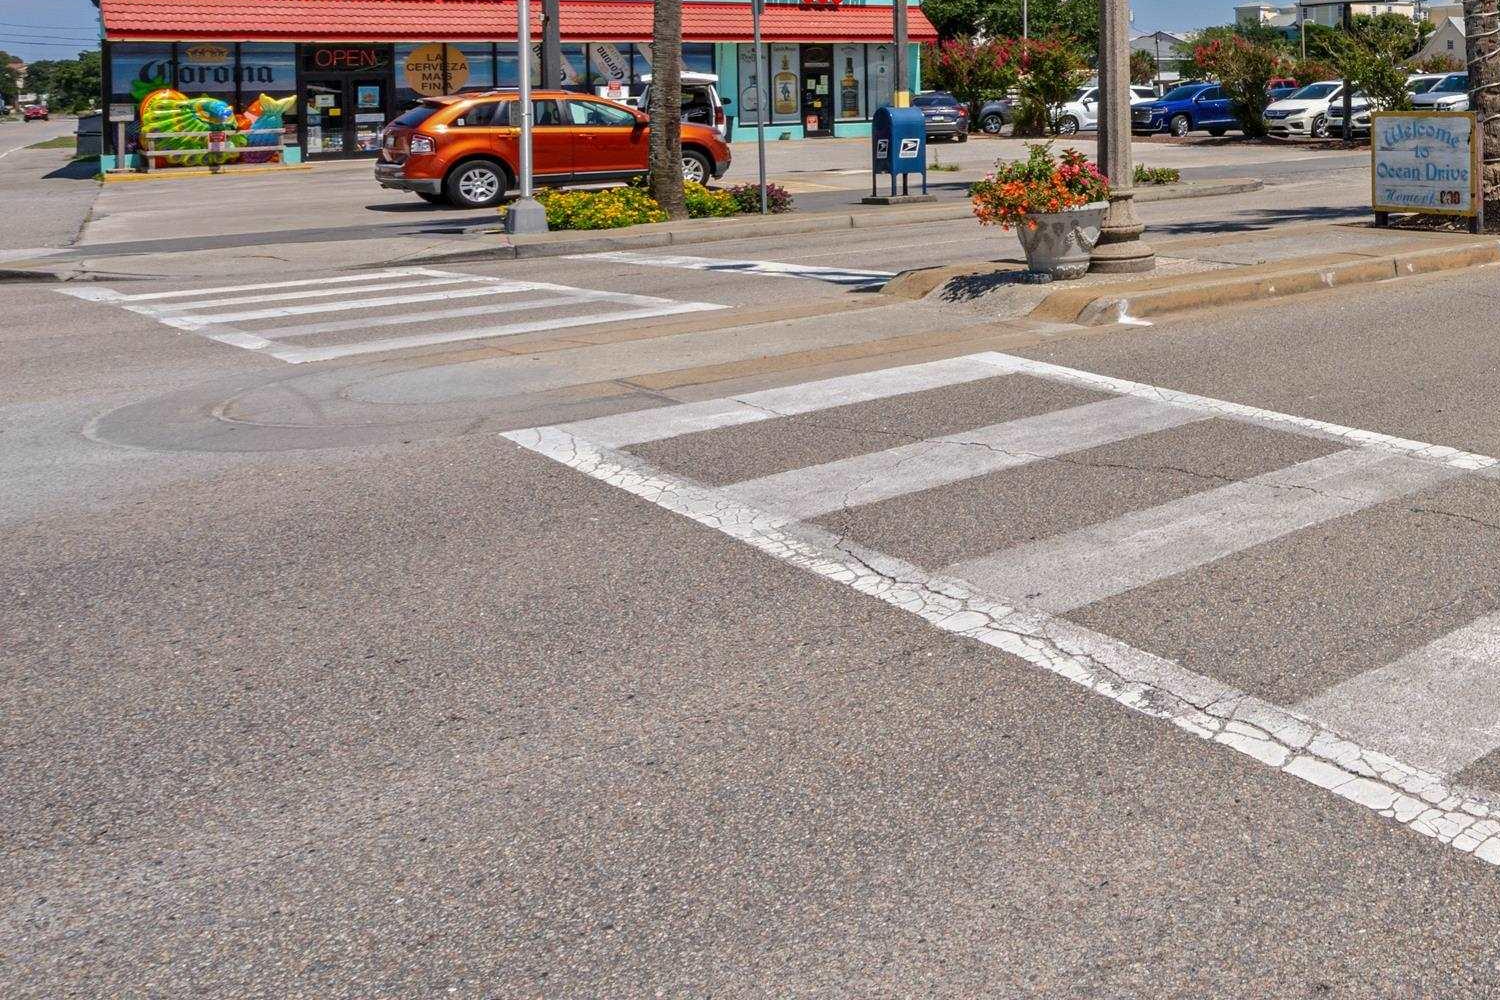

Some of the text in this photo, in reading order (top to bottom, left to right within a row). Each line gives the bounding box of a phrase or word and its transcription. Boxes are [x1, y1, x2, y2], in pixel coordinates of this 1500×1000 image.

[315, 49, 376, 68] OPEN
[139, 60, 274, 84] Corona
[1384, 121, 1460, 149] Welcome
[1414, 144, 1430, 159] to
[1377, 162, 1469, 181] Ocean Drive
